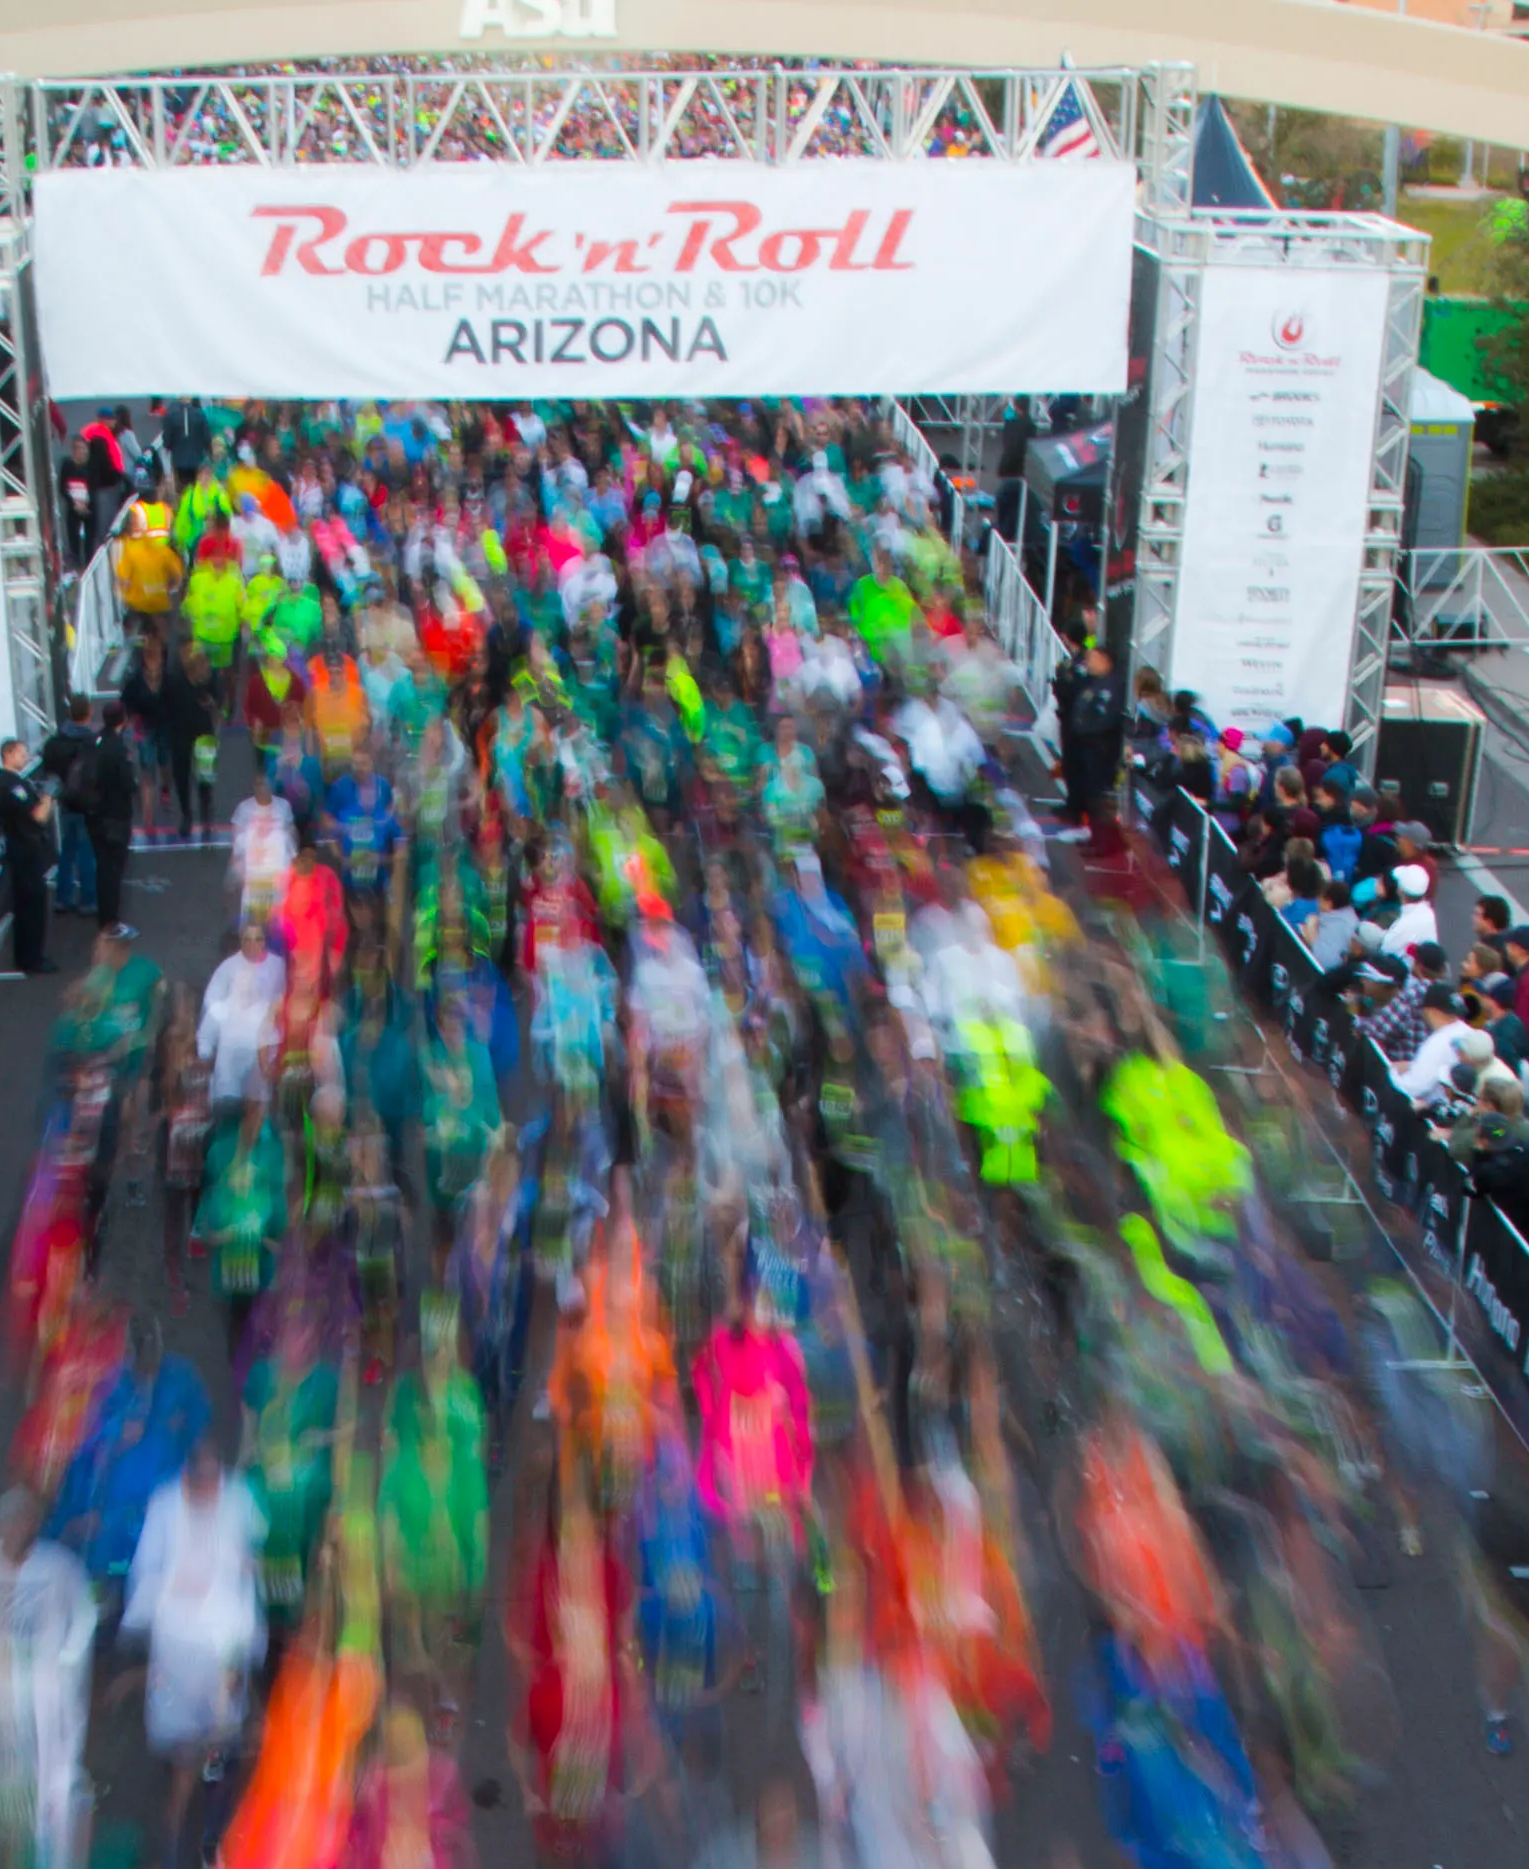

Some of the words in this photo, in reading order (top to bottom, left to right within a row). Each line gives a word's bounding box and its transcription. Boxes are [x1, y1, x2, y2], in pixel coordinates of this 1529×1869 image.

[250, 204, 563, 276] Rock
[666, 200, 917, 273] Roll
[366, 282, 464, 313] HALF
[475, 280, 691, 312] MARATHON
[703, 281, 727, 310] &
[738, 279, 804, 310] 10K
[442, 315, 730, 364] ARIZONA
